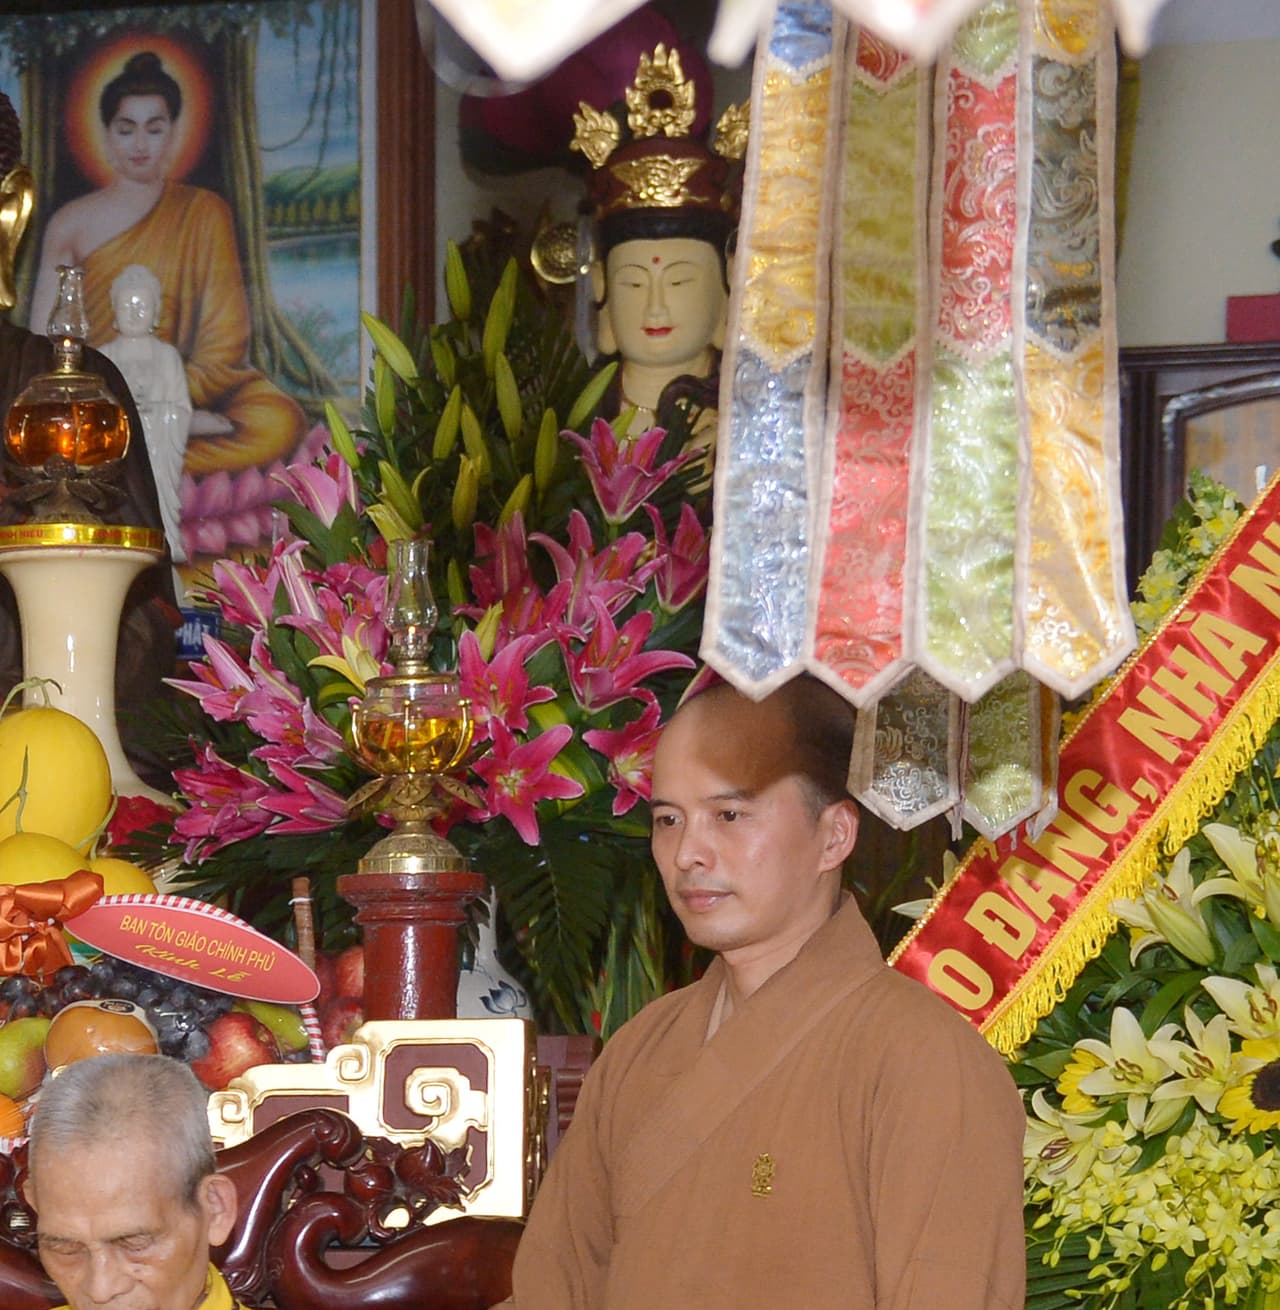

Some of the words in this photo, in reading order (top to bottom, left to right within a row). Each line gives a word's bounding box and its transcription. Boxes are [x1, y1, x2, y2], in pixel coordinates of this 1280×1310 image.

[1117, 611, 1268, 765] NHÀ
[119, 914, 148, 936] BAN
[148, 921, 176, 944] TÔN
[175, 930, 207, 953] GIÁO
[207, 939, 248, 963] CHÍNH
[246, 948, 276, 972] PHỦ
